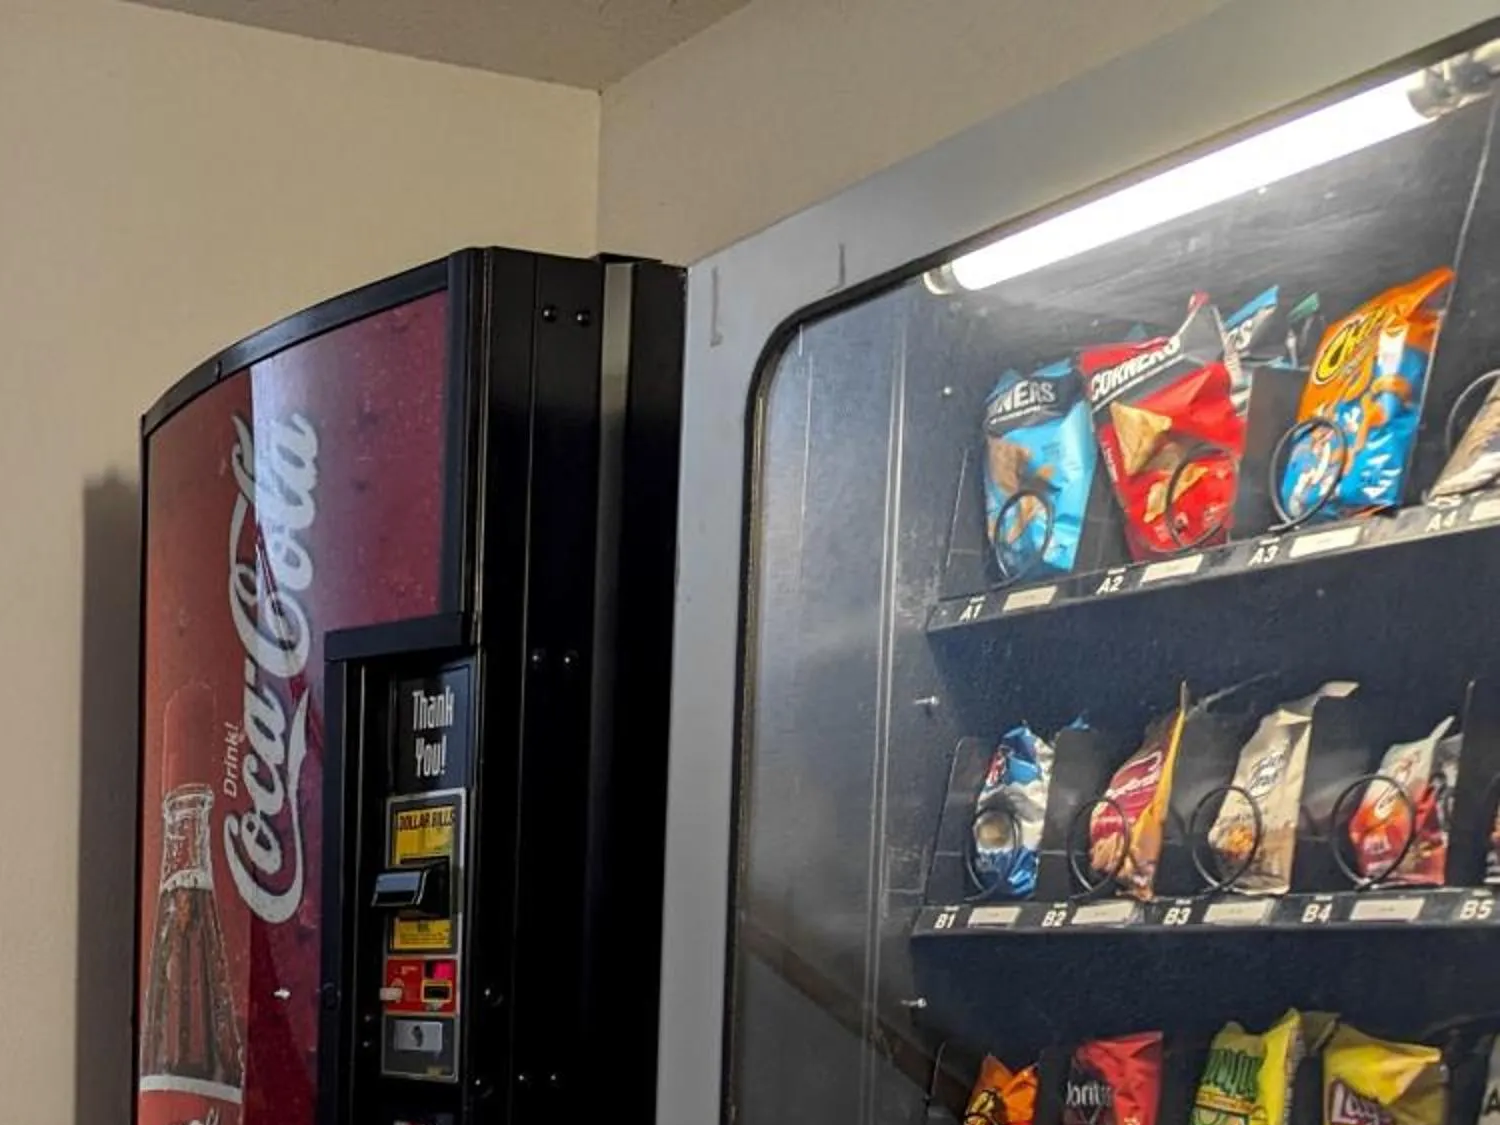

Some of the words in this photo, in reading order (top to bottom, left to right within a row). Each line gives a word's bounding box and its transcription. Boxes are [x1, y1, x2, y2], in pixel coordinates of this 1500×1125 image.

[1425, 511, 1460, 533] A4
[1248, 545, 1279, 567] A3
[1096, 576, 1125, 595] A2
[960, 603, 983, 621] A1
[223, 411, 319, 924] Coca-Cola
[412, 686, 456, 731] Thank
[223, 721, 245, 798] Drink!
[415, 734, 447, 778] You!
[1042, 910, 1067, 928] B2
[1163, 907, 1192, 926] B3
[1301, 902, 1334, 923] B4
[1460, 899, 1495, 920] B5
[934, 913, 957, 929] B1
